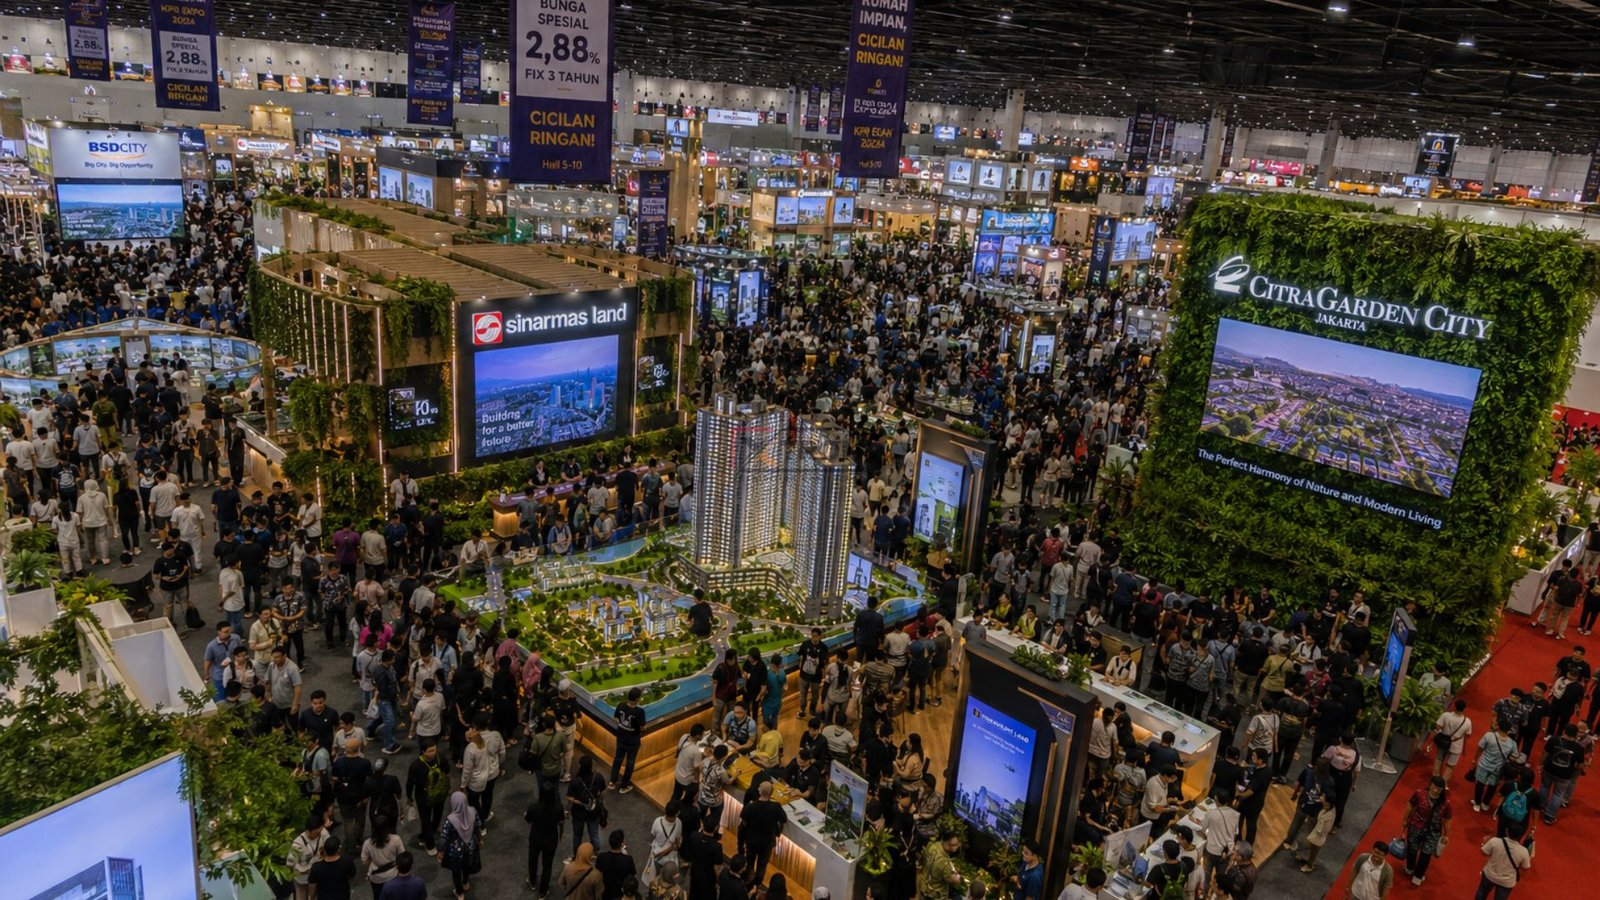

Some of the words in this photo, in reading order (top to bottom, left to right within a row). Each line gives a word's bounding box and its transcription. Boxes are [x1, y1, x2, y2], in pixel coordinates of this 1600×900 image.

[540, 0, 587, 14] BUNGA
[538, 13, 589, 30] SPESIAL
[860, 10, 907, 33] IMPIAN,
[526, 30, 600, 65] 2,88%
[858, 33, 905, 51] CICILAN
[856, 51, 904, 68] RINGAN!
[525, 68, 544, 80] FIX
[548, 70, 555, 80] 3
[559, 71, 600, 84] TAHUN
[530, 110, 595, 128] CICILAN
[530, 130, 595, 147] RINGAN!
[562, 160, 582, 169] 5-10
[506, 312, 588, 334] sinarmas
[592, 302, 627, 324] land
[1315, 313, 1366, 332] JAKARTA
[1198, 448, 1214, 461] The
[1215, 450, 1248, 471] Perfect
[1249, 462, 1292, 485] Harmony
[1293, 477, 1304, 487] of
[1305, 481, 1340, 499] Nature
[1341, 490, 1362, 504] and
[1364, 497, 1406, 517] Modern
[1408, 509, 1442, 529] Living
